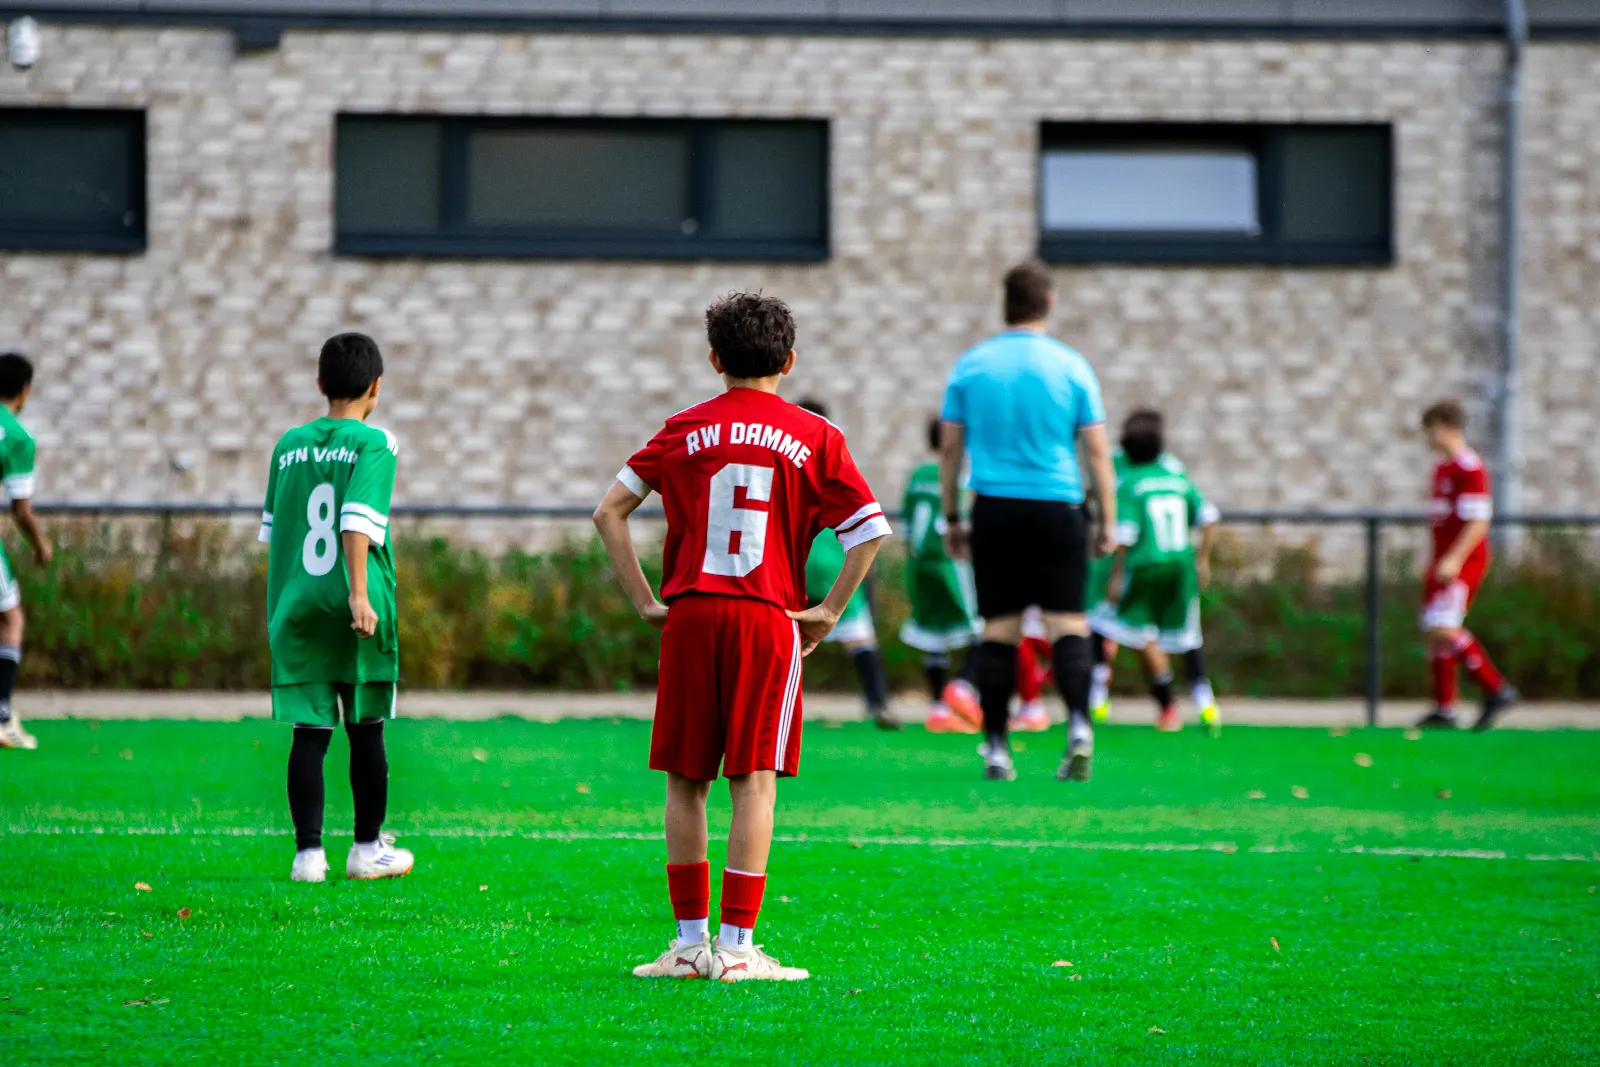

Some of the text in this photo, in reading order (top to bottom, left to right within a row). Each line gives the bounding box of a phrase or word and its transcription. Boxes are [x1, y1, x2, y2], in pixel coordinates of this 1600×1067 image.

[279, 446, 308, 470] SFN
[685, 422, 812, 469] RW DAMME
[303, 483, 337, 576] 8
[702, 463, 774, 577] 6
